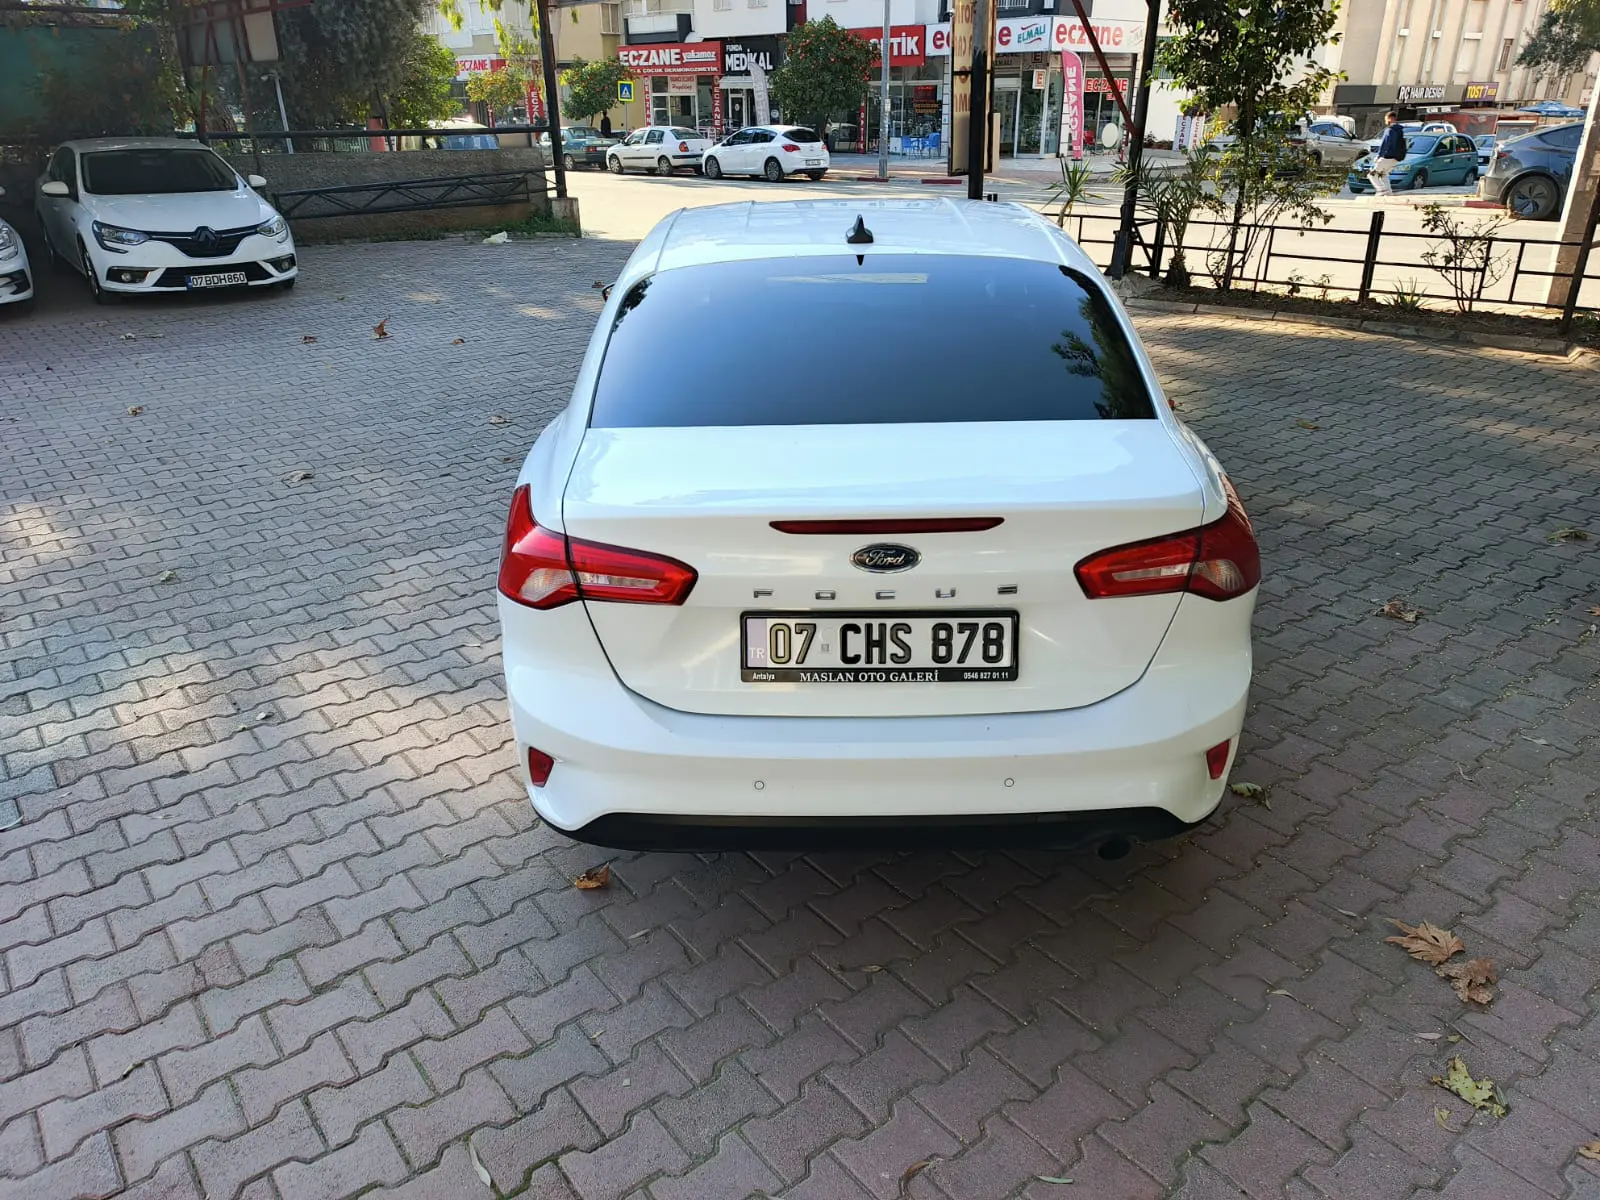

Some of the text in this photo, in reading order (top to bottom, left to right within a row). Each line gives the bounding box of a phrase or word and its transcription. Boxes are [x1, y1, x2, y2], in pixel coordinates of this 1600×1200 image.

[1017, 23, 1046, 43] ELMALI
[618, 48, 681, 66] ECZANE
[725, 48, 773, 71] MEDİKAL
[1410, 87, 1425, 99] HAIR
[1466, 85, 1483, 99] TOST
[713, 86, 721, 125] ECZANE
[865, 549, 905, 567] Ford
[769, 622, 1005, 664] 07 CHS 878
[750, 647, 765, 659] TR
[752, 672, 776, 681] Antalya
[799, 671, 855, 682] MASLAN
[858, 671, 888, 682] OTO
[889, 669, 940, 682] GALERİ
